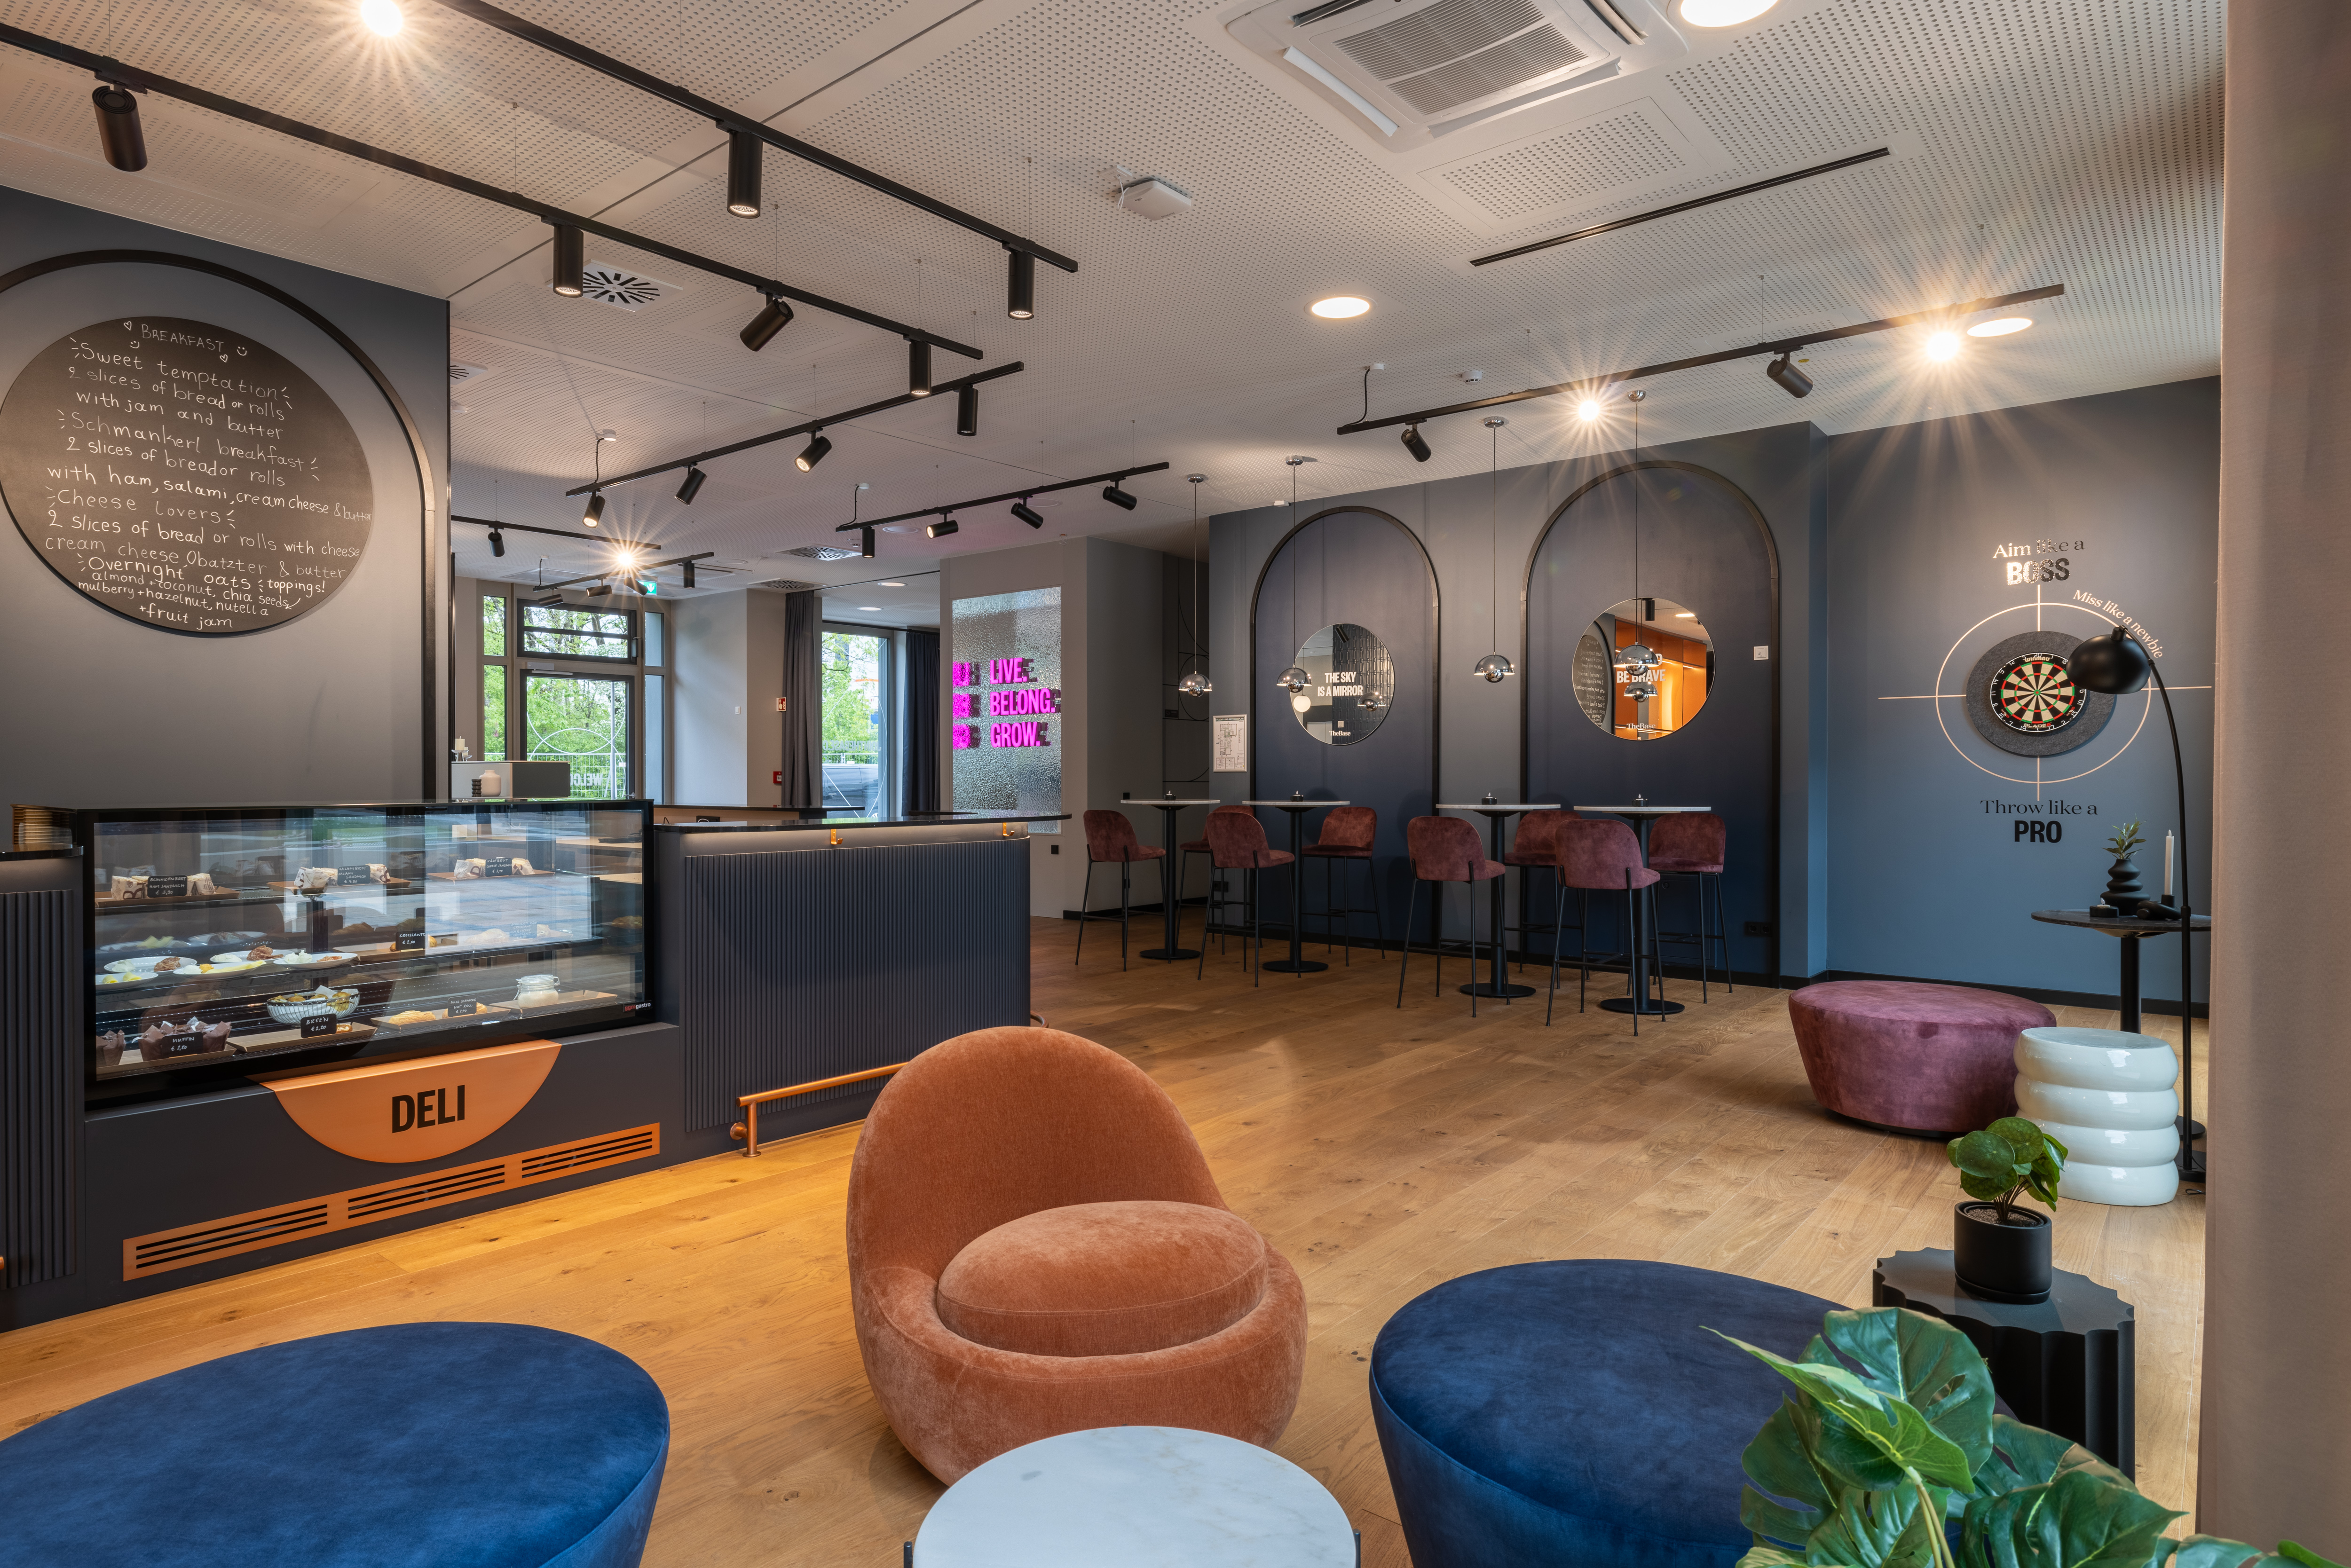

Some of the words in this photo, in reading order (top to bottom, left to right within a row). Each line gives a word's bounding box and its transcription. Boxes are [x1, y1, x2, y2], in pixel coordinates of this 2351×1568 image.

[142, 324, 224, 352] BREAKFAST
[81, 342, 142, 370] Sweet
[157, 361, 278, 401] temptation
[69, 366, 81, 379] 2
[87, 369, 141, 389] slices
[152, 380, 166, 394] of
[174, 383, 225, 409] bread
[249, 402, 284, 420] rolls
[76, 392, 119, 408] with
[125, 400, 164, 415] jam
[177, 410, 213, 425] and
[228, 415, 283, 439] butter
[72, 412, 200, 453] Schmankerl
[217, 439, 304, 471] breakfast
[66, 436, 80, 450] 2
[88, 439, 133, 456] slices
[141, 449, 157, 461] of
[251, 470, 285, 486] rolls
[47, 463, 96, 485] with
[108, 465, 158, 493] ham,
[164, 480, 234, 504] salami,
[288, 495, 329, 513] cheese
[333, 502, 342, 517] &
[58, 489, 136, 511] Cheese
[48, 510, 63, 528] 2
[132, 520, 149, 537] of
[158, 523, 203, 544] bread
[213, 534, 230, 543] or
[240, 532, 276, 551] rolls
[284, 540, 314, 555] with
[321, 541, 360, 557] cheese
[46, 537, 105, 552] cream
[187, 550, 267, 574] Obatzter
[280, 561, 290, 577] &
[296, 564, 347, 578] butter
[1993, 543, 2032, 559] Aim
[2036, 538, 2069, 554] like
[2074, 540, 2085, 551] a
[89, 557, 184, 583] Overnight
[204, 575, 251, 589] oats
[267, 579, 325, 598] toppings!
[2007, 558, 2070, 585] BOSS
[79, 582, 134, 599] mulberry
[92, 571, 144, 585] almond
[223, 588, 252, 601] chia
[196, 617, 233, 630] jam
[2073, 590, 2103, 607] Miss
[2102, 600, 2124, 619] like
[2123, 616, 2132, 625] a
[2130, 622, 2163, 658] newbie
[990, 657, 1028, 685] LIVE.
[1325, 672, 1340, 683] THE
[1341, 671, 1357, 682] SKY
[1617, 671, 1630, 683] BE
[990, 687, 1056, 717] BELONG.
[1318, 686, 1325, 697] IS
[1325, 686, 1332, 696] A
[1333, 685, 1363, 697] MIRROR
[990, 721, 1041, 748] GROW.
[1980, 799, 2044, 814] Throw
[2049, 800, 2082, 815] like
[2087, 804, 2099, 815] a
[2014, 820, 2062, 843] PRO
[624, 1002, 651, 1011] ggmgastro
[392, 1084, 465, 1134] DELI
